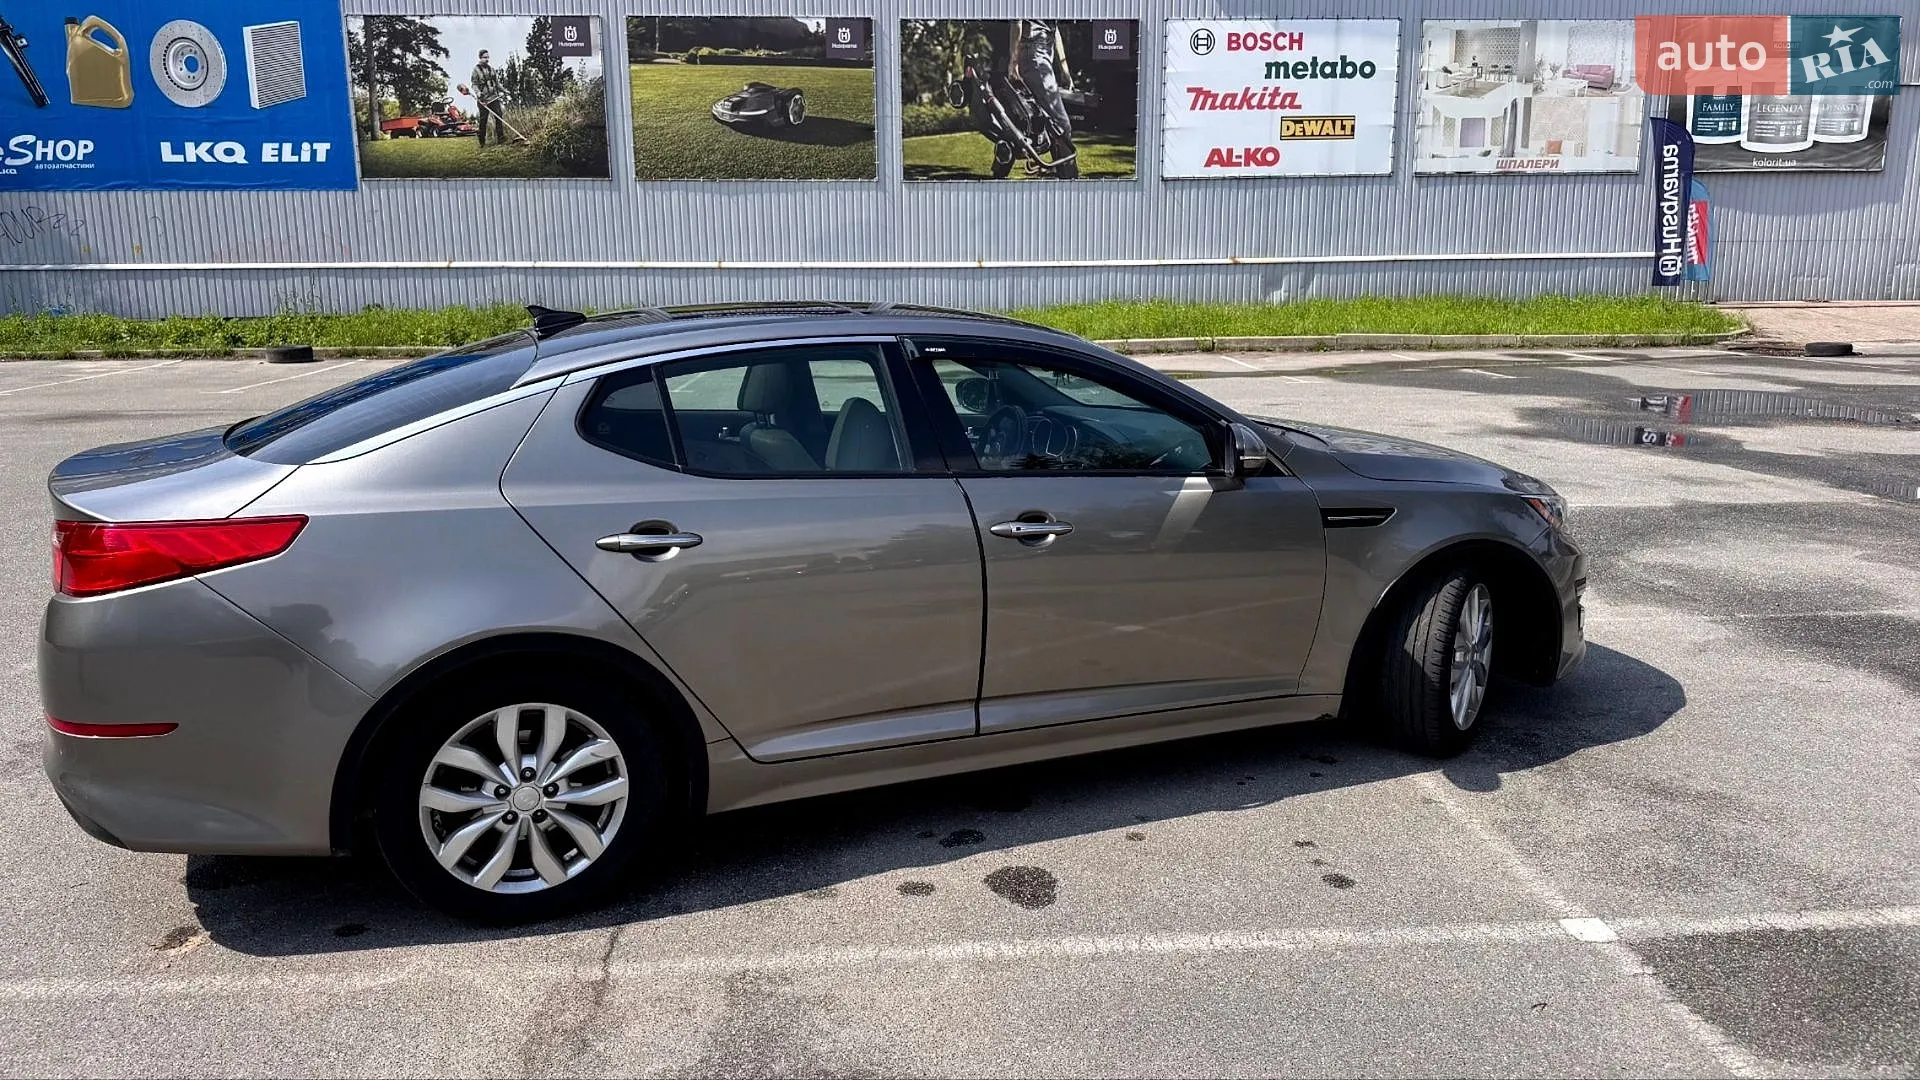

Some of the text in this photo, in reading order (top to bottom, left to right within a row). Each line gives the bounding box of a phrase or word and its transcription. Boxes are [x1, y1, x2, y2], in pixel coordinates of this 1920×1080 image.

[1227, 32, 1304, 51] BOSCH
[1264, 55, 1376, 80] metabo
[1702, 102, 1735, 111] FAMILY
[160, 141, 249, 164] LKQ
[1204, 147, 1280, 168] AL-KO
[1495, 159, 1560, 170] ШПАЛЕРИ
[1752, 158, 1797, 168] kolorit.ua
